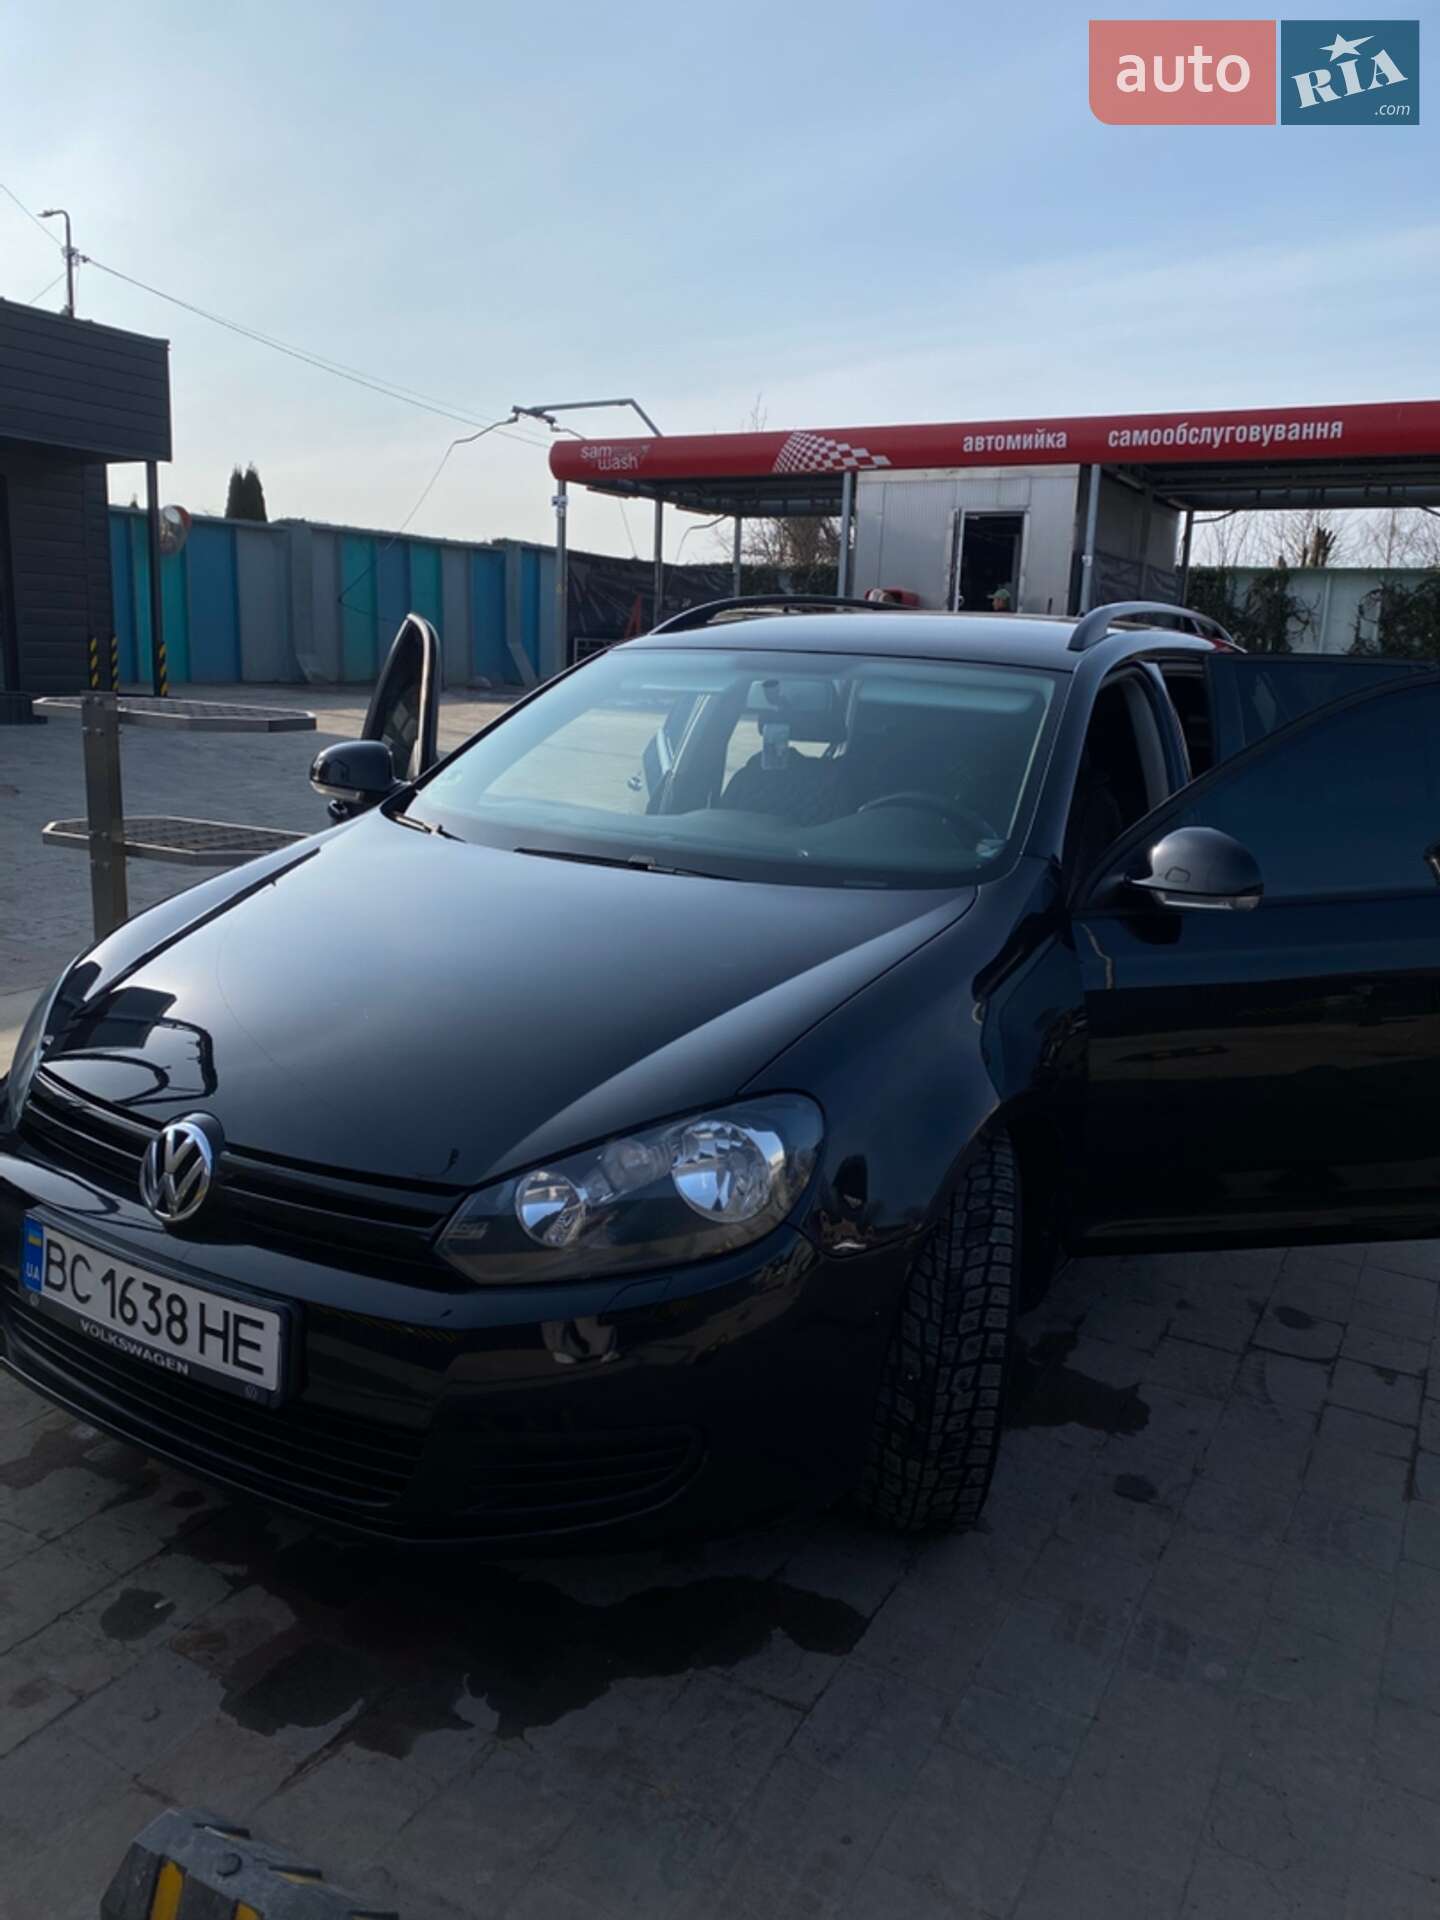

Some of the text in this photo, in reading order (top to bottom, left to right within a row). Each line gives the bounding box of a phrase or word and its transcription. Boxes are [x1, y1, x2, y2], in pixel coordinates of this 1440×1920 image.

[962, 420, 1344, 453] автомийка самообслуговування
[580, 446, 612, 459] sam
[597, 452, 639, 470] wash
[26, 1262, 41, 1281] UA
[44, 1238, 265, 1376] BC 1638 HE
[79, 1319, 189, 1376] VOLKSWAGEN
